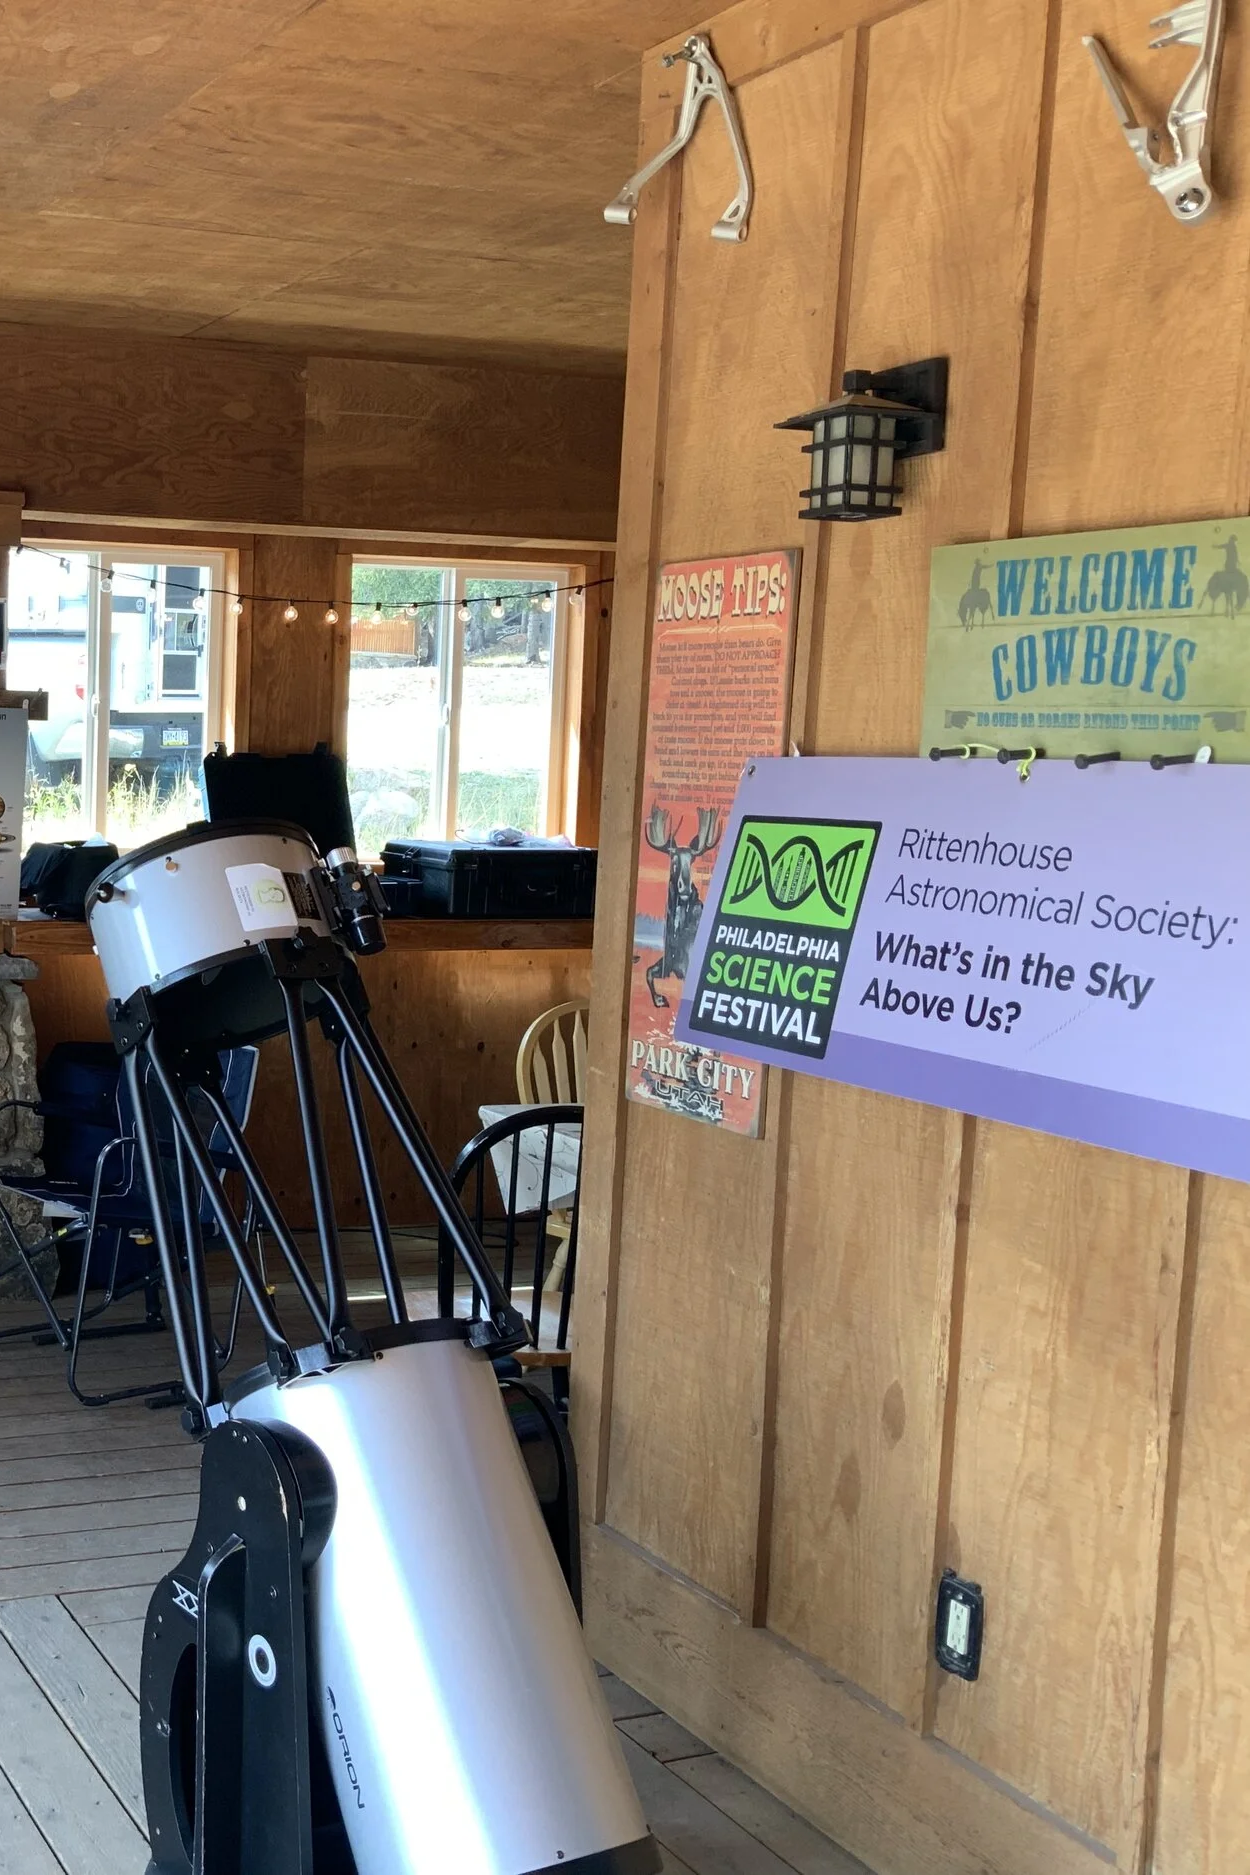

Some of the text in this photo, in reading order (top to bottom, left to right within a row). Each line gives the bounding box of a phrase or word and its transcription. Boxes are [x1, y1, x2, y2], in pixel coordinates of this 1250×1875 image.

[657, 560, 787, 622] MOOSE TIPS:
[996, 545, 1198, 617] WELCOME
[991, 625, 1198, 702] COWBOYS
[976, 712, 990, 727] NO
[1131, 714, 1160, 730] THIS
[1161, 714, 1200, 731] POINT
[898, 828, 1073, 872] Rittenhouse
[885, 874, 1239, 951] Astronomical Society:
[716, 925, 840, 963] PHILADELPHIA
[875, 931, 1155, 1011] What's in the Sky
[706, 951, 837, 1005] SCIENCE
[860, 977, 1022, 1035] Above Us?
[697, 990, 822, 1045] FESTIVAL
[631, 1040, 755, 1100] PARK CITY
[655, 1080, 724, 1111] UTAH
[332, 1712, 365, 1809] ORION
